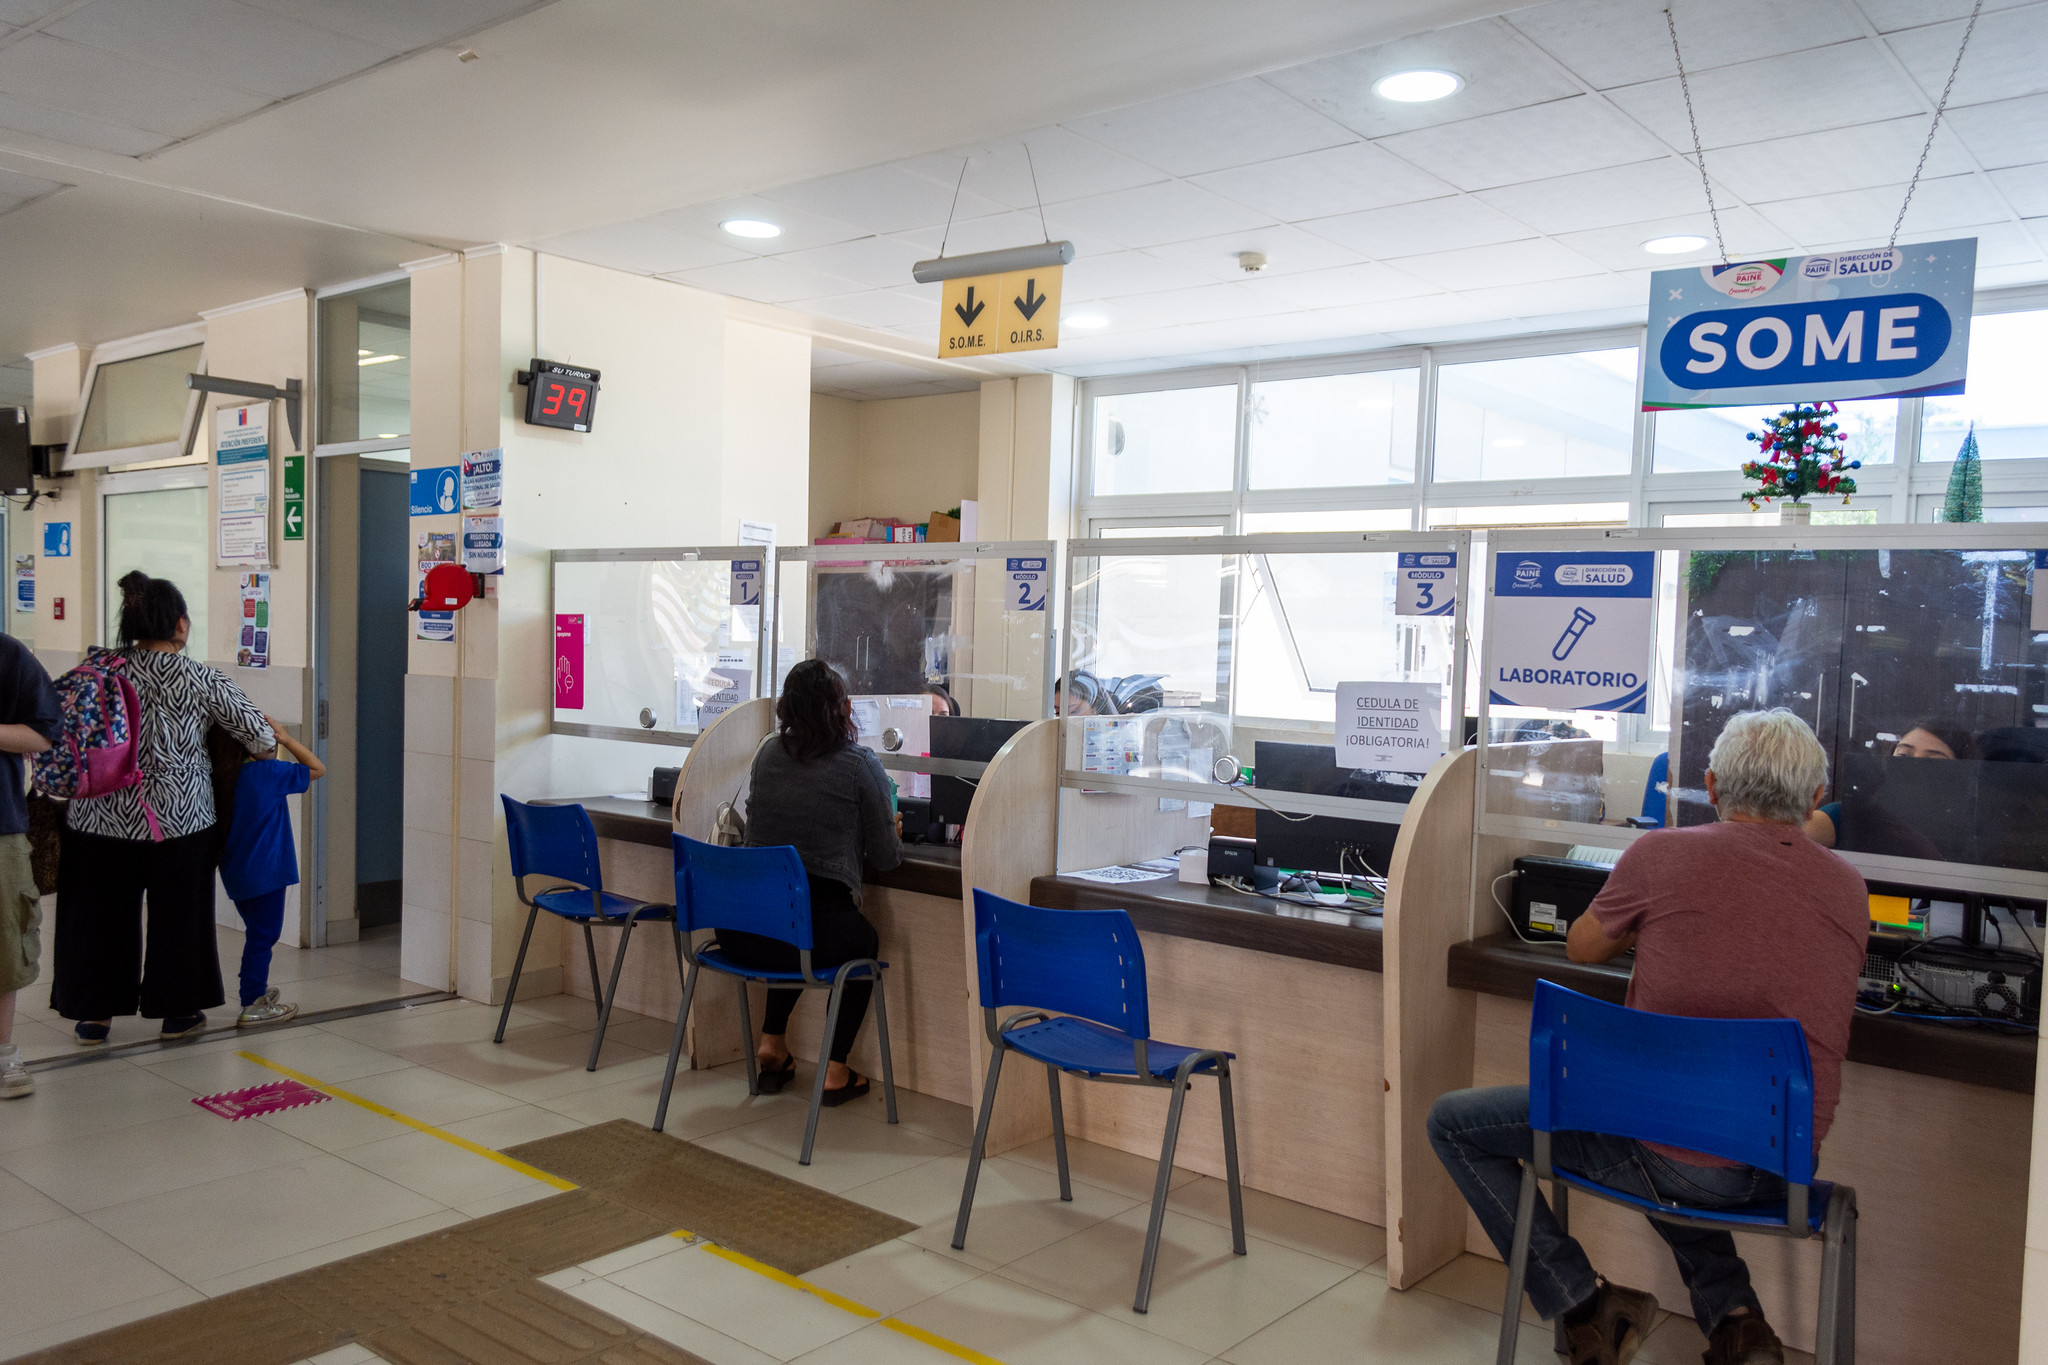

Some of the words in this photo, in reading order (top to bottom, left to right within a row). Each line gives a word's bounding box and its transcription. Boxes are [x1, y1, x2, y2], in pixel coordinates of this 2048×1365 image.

[1840, 252, 1881, 262] DIRECCIÓN
[1805, 266, 1830, 274] PAINE
[1839, 260, 1893, 275] SALUD
[1736, 274, 1762, 282] PAINE
[949, 334, 986, 350] S.O.M.E.
[1010, 328, 1044, 344] O.I.R.S.
[1685, 305, 1920, 374] SOME
[552, 366, 564, 374] SU
[565, 368, 591, 379] TURNO
[542, 384, 586, 418] 39
[473, 462, 493, 476] ¡ALTO!
[411, 505, 432, 514] Silencio
[478, 550, 497, 559] NÚMERO
[1585, 574, 1625, 583] SALUD
[741, 581, 747, 600] 1
[1018, 583, 1030, 604] 2
[1416, 583, 1433, 608] 3
[1500, 667, 1637, 688] LABORATORIO
[1357, 697, 1400, 708] CEDULA
[1404, 699, 1419, 709] DE
[1358, 716, 1418, 728] IDENTIDAD
[1346, 735, 1430, 748] ¡OBLIGATORIA!
